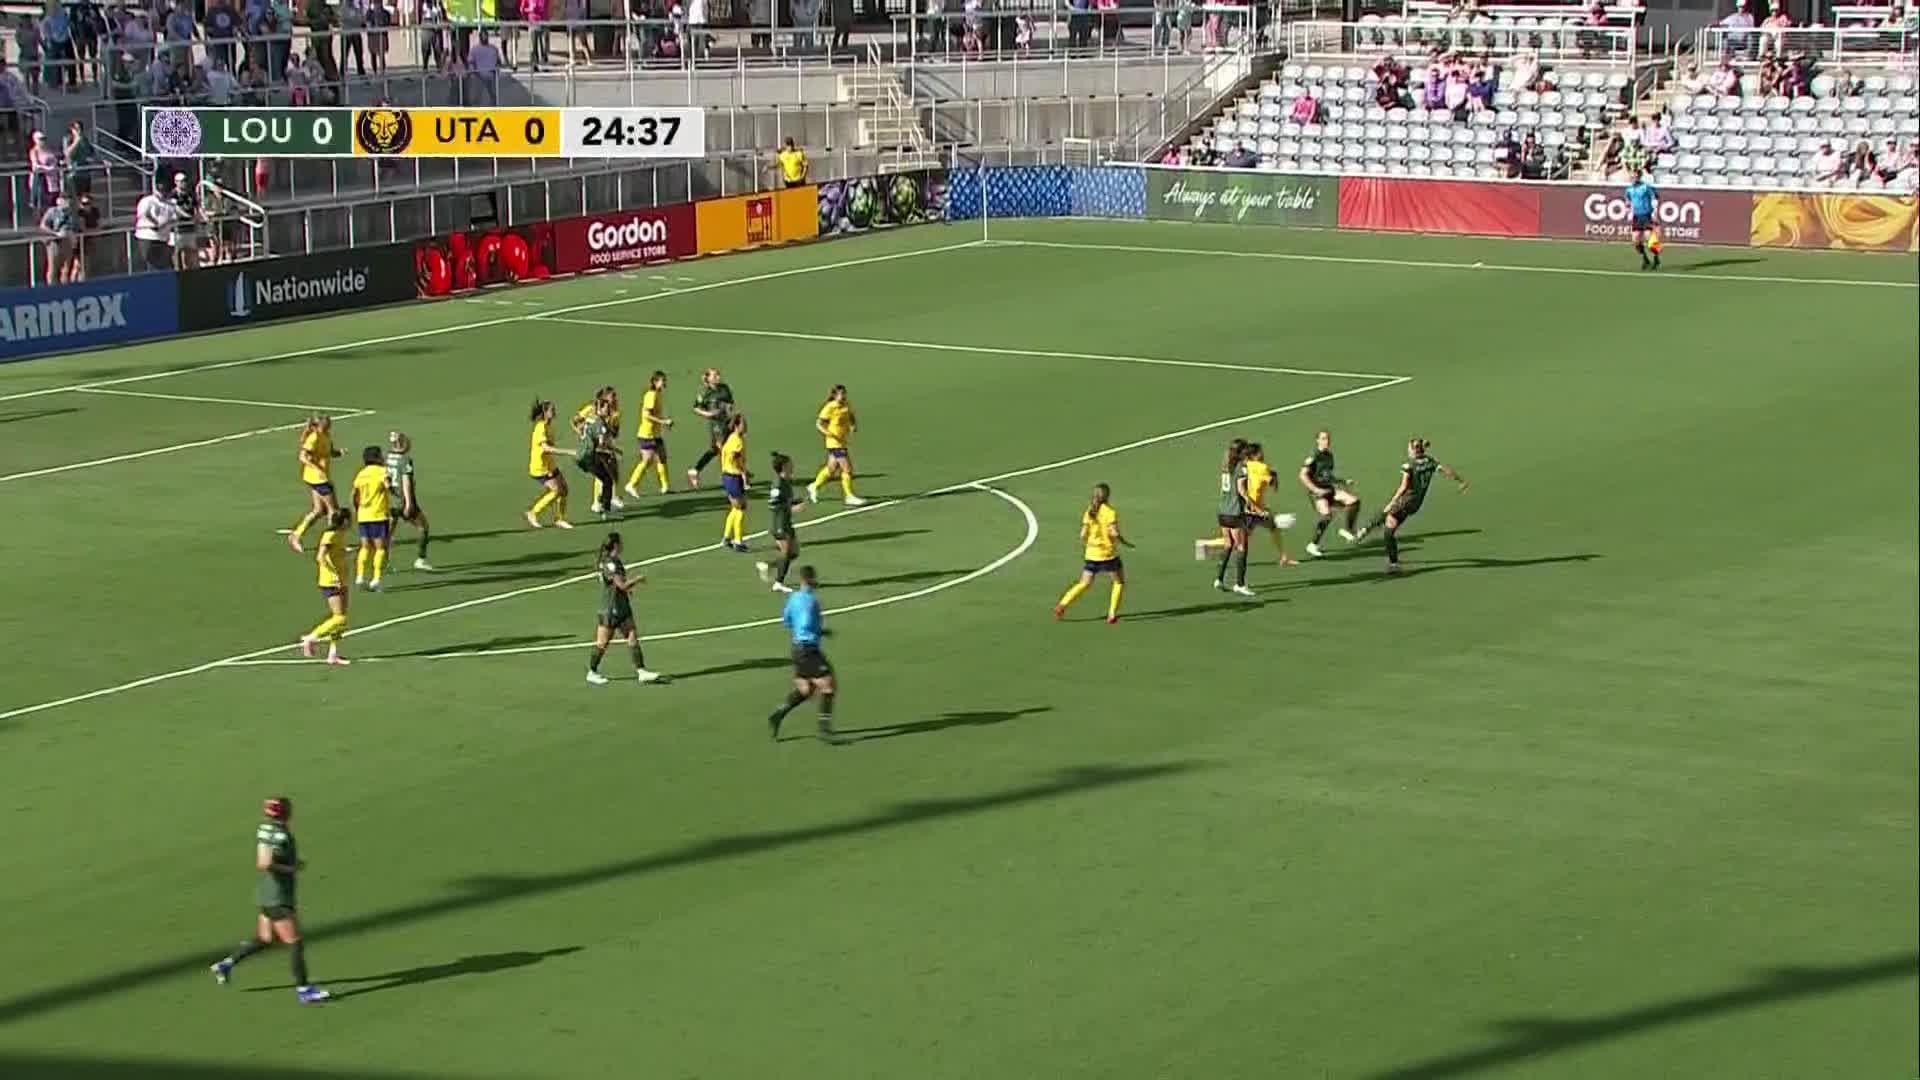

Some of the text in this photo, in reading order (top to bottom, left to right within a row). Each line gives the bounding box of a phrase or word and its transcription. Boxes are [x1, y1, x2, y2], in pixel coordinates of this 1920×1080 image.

[1163, 181, 1315, 221] Always at your table
[1584, 193, 1701, 223] Goon
[588, 217, 666, 249] Gordon
[1585, 224, 1615, 236] FOOD
[255, 270, 366, 304] Nationwide
